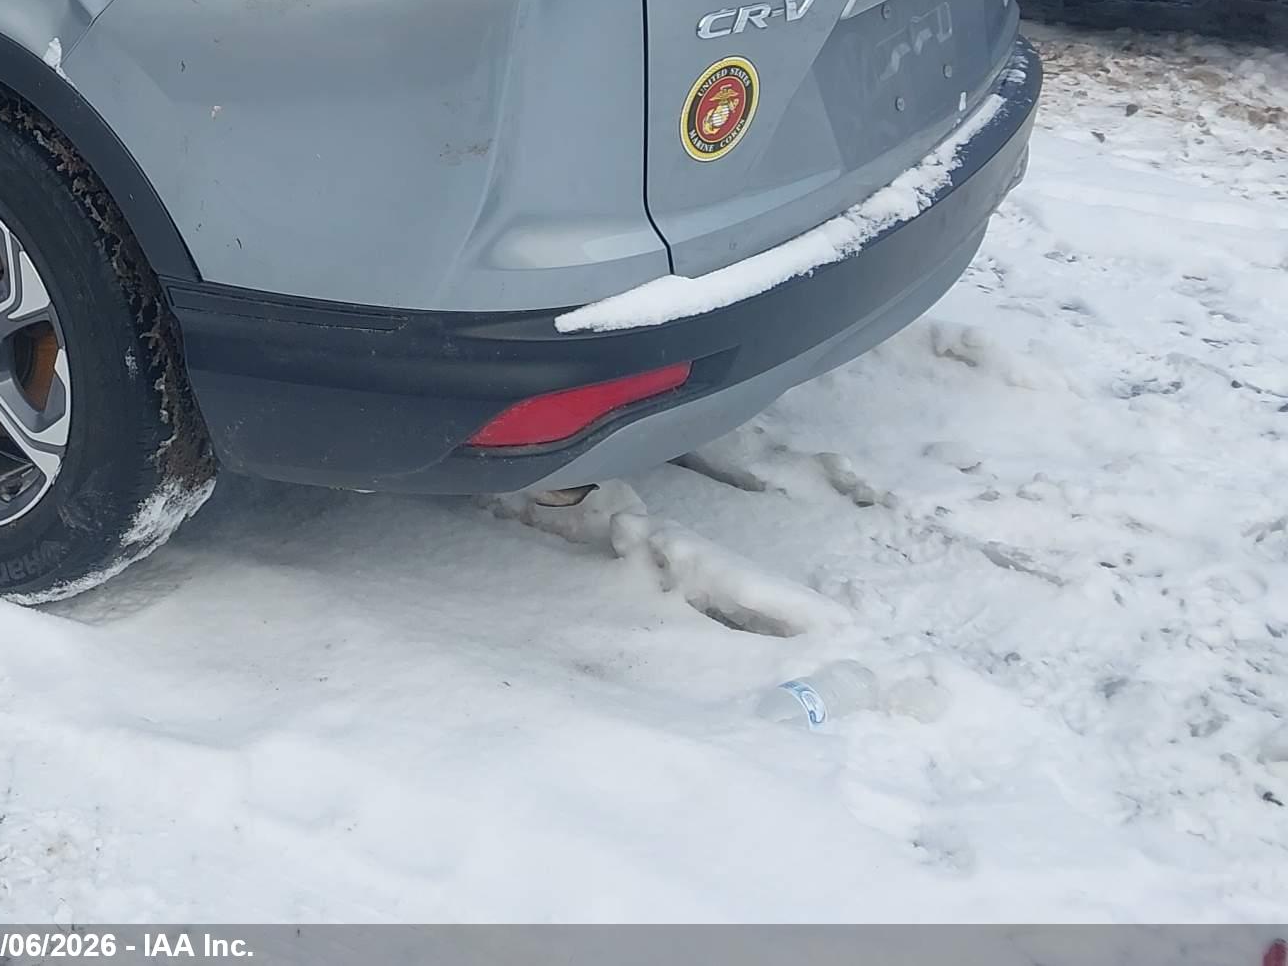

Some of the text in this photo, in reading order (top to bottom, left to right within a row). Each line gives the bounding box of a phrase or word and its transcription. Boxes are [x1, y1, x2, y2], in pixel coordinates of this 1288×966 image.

[697, 67, 751, 97] UNITED STATES
[688, 129, 714, 152] MARINE
